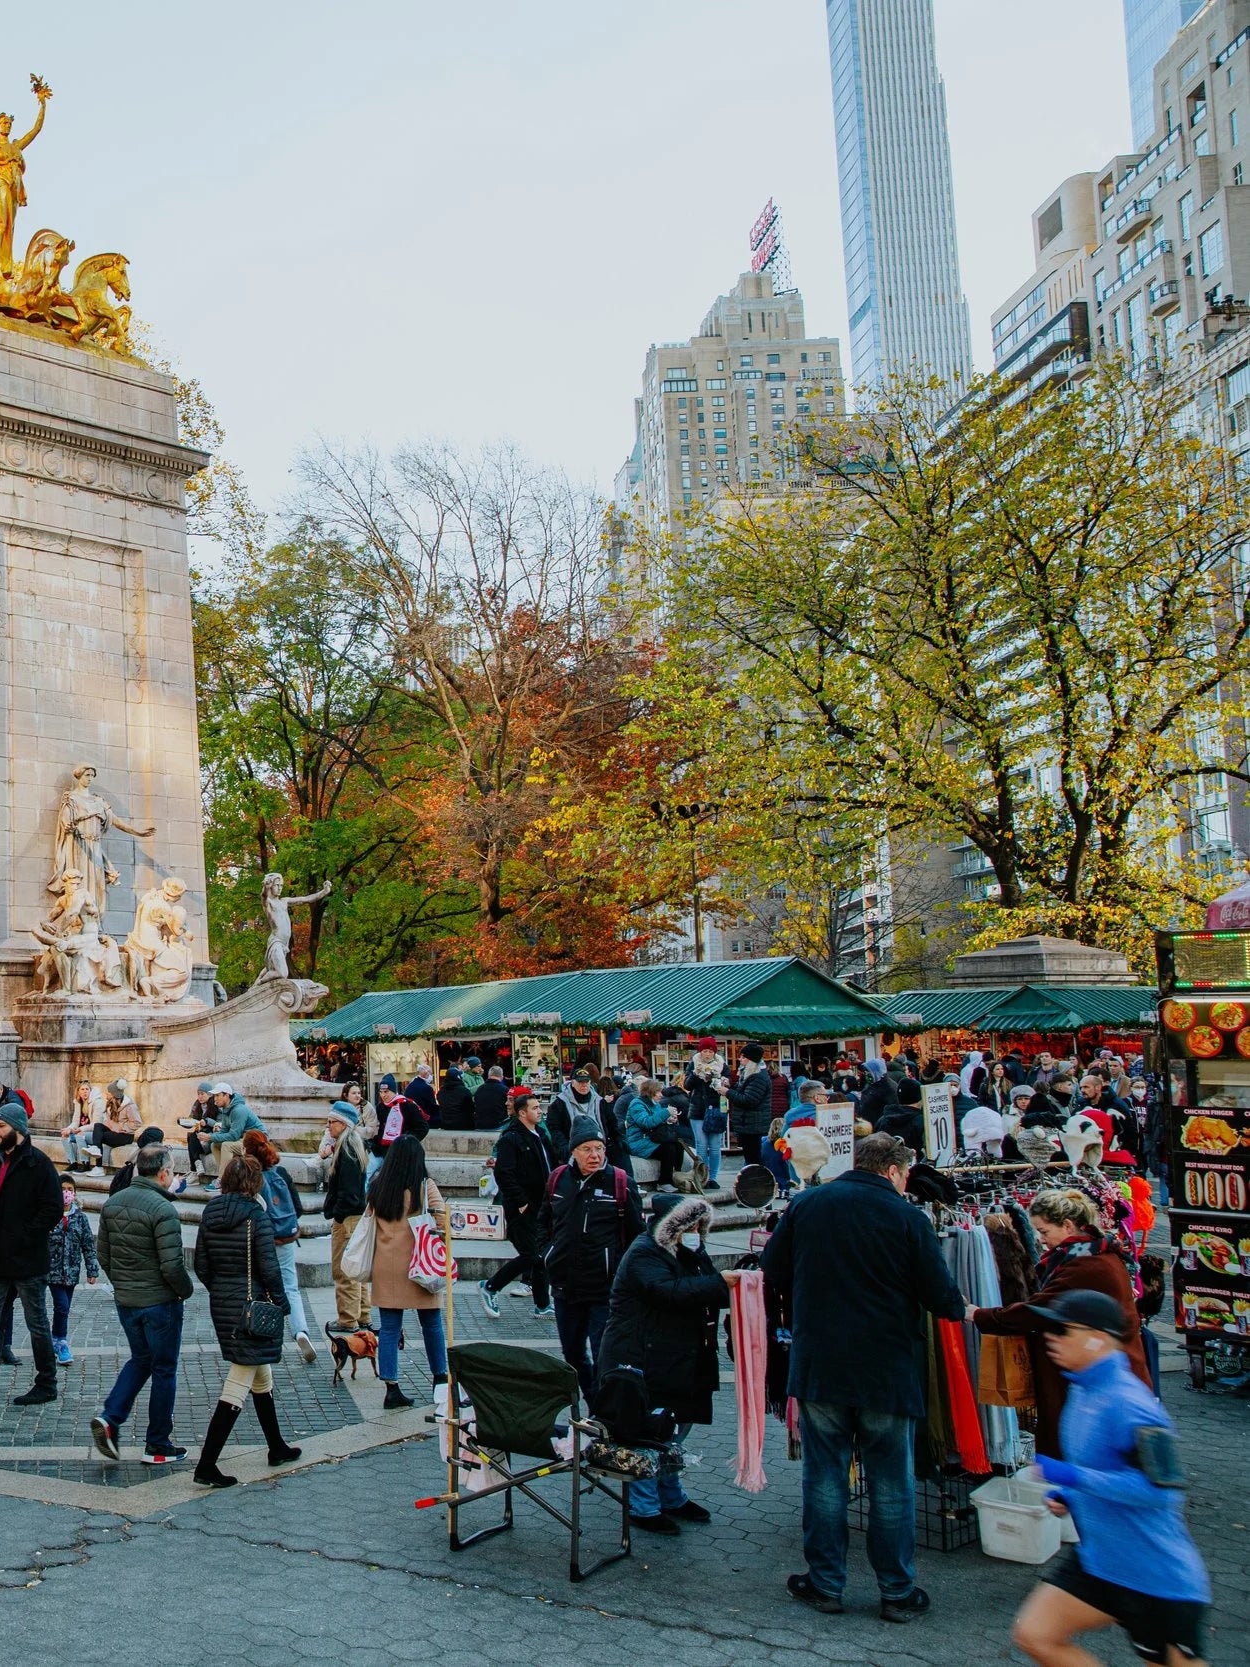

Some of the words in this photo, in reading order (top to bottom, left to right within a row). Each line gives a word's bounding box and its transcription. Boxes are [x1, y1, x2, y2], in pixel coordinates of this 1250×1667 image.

[930, 1104, 948, 1114] SCARVES
[830, 1141, 852, 1156] ARVES
[1188, 1224, 1214, 1232] CHICKEN
[1215, 1226, 1232, 1234] GYRO
[1185, 1285, 1231, 1296] CHEESEBURGER
